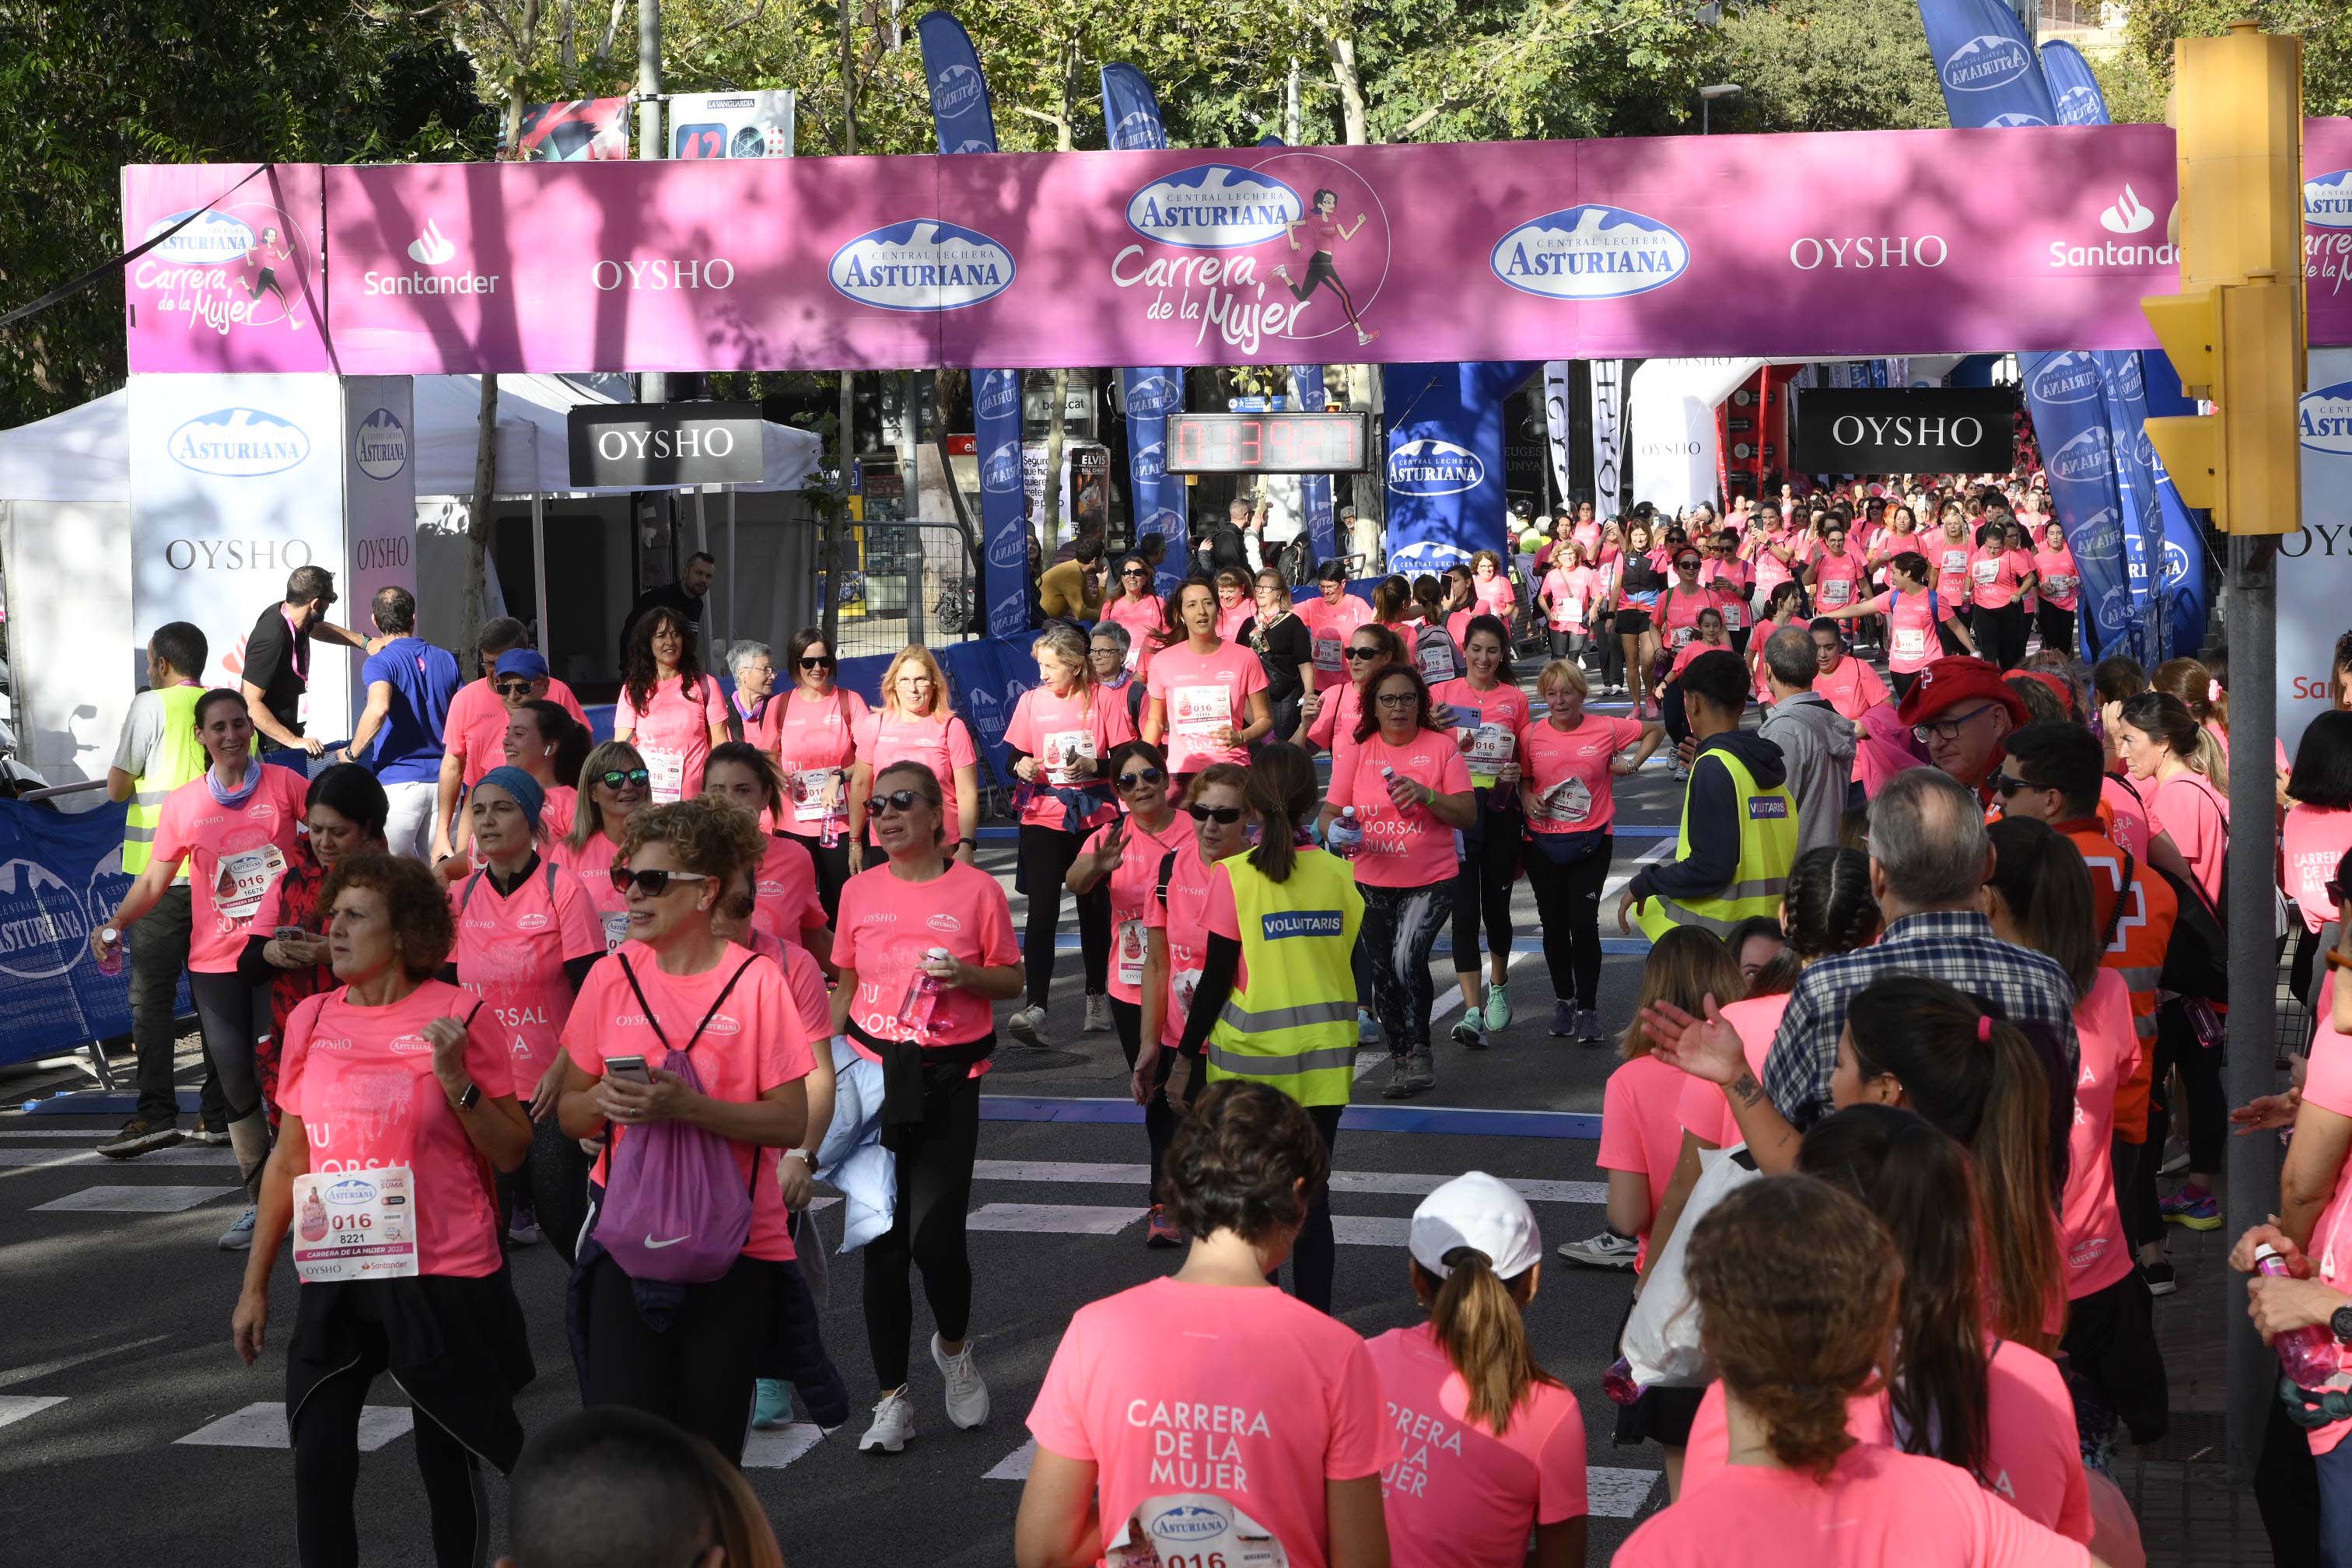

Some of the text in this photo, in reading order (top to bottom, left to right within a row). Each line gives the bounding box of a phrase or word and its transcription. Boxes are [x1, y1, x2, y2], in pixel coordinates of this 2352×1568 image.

[1167, 191, 1284, 201] CENTRAL LECHERA
[1139, 195, 1289, 229] ASTURIANA
[1537, 236, 1668, 247] CENTRAL LECHERA
[1790, 235, 1948, 269] OYSHO
[939, 250, 995, 259] LECHERA
[1506, 242, 1674, 276] ASTURIANA
[2049, 240, 2180, 267] Santand
[135, 261, 226, 290] Carrera
[591, 258, 734, 290] OYSHO
[843, 254, 1001, 288] ASTURIANA
[1111, 243, 1256, 288] Carrera
[2322, 256, 2336, 277] la
[364, 271, 499, 295] Santander
[158, 287, 262, 335] de la Mujer
[1146, 282, 1311, 355] de la Mujer
[1832, 415, 1983, 447] OYSHO
[180, 433, 299, 460] ASTURIANA
[359, 435, 404, 462] ASTURIANA
[599, 427, 733, 461] OYSHO
[1081, 455, 1106, 464] ELVIS
[1024, 469, 1036, 478] que
[1389, 462, 1478, 484] ASTURIANA
[2277, 524, 2352, 557] OY
[166, 538, 313, 570] OYSHO
[357, 536, 409, 570] OYSHO
[1475, 741, 1495, 751] 016
[1360, 804, 1380, 817] TU
[193, 816, 224, 828] OYSHO
[1365, 821, 1425, 835] DORSAL
[1365, 838, 1407, 853] SUMA
[233, 861, 261, 872] ASTURIANA
[239, 875, 264, 888] 016
[244, 887, 264, 896] 16676
[227, 898, 248, 908] CARRERA
[864, 913, 897, 923] OYSHO
[1171, 943, 1192, 961] TU
[861, 982, 879, 1003] TU
[330, 1191, 373, 1199] ASTURIANA
[332, 1213, 372, 1230] 016
[340, 1234, 365, 1244] 8221
[306, 1249, 339, 1258] CARRERA
[306, 1261, 407, 1275] OYSHO Santander
[1128, 1399, 1271, 1438] CARRERA
[1155, 1430, 1242, 1464] DE LA
[1150, 1458, 1248, 1493] MUJER
[1159, 1520, 1223, 1534] ASTURIANA
